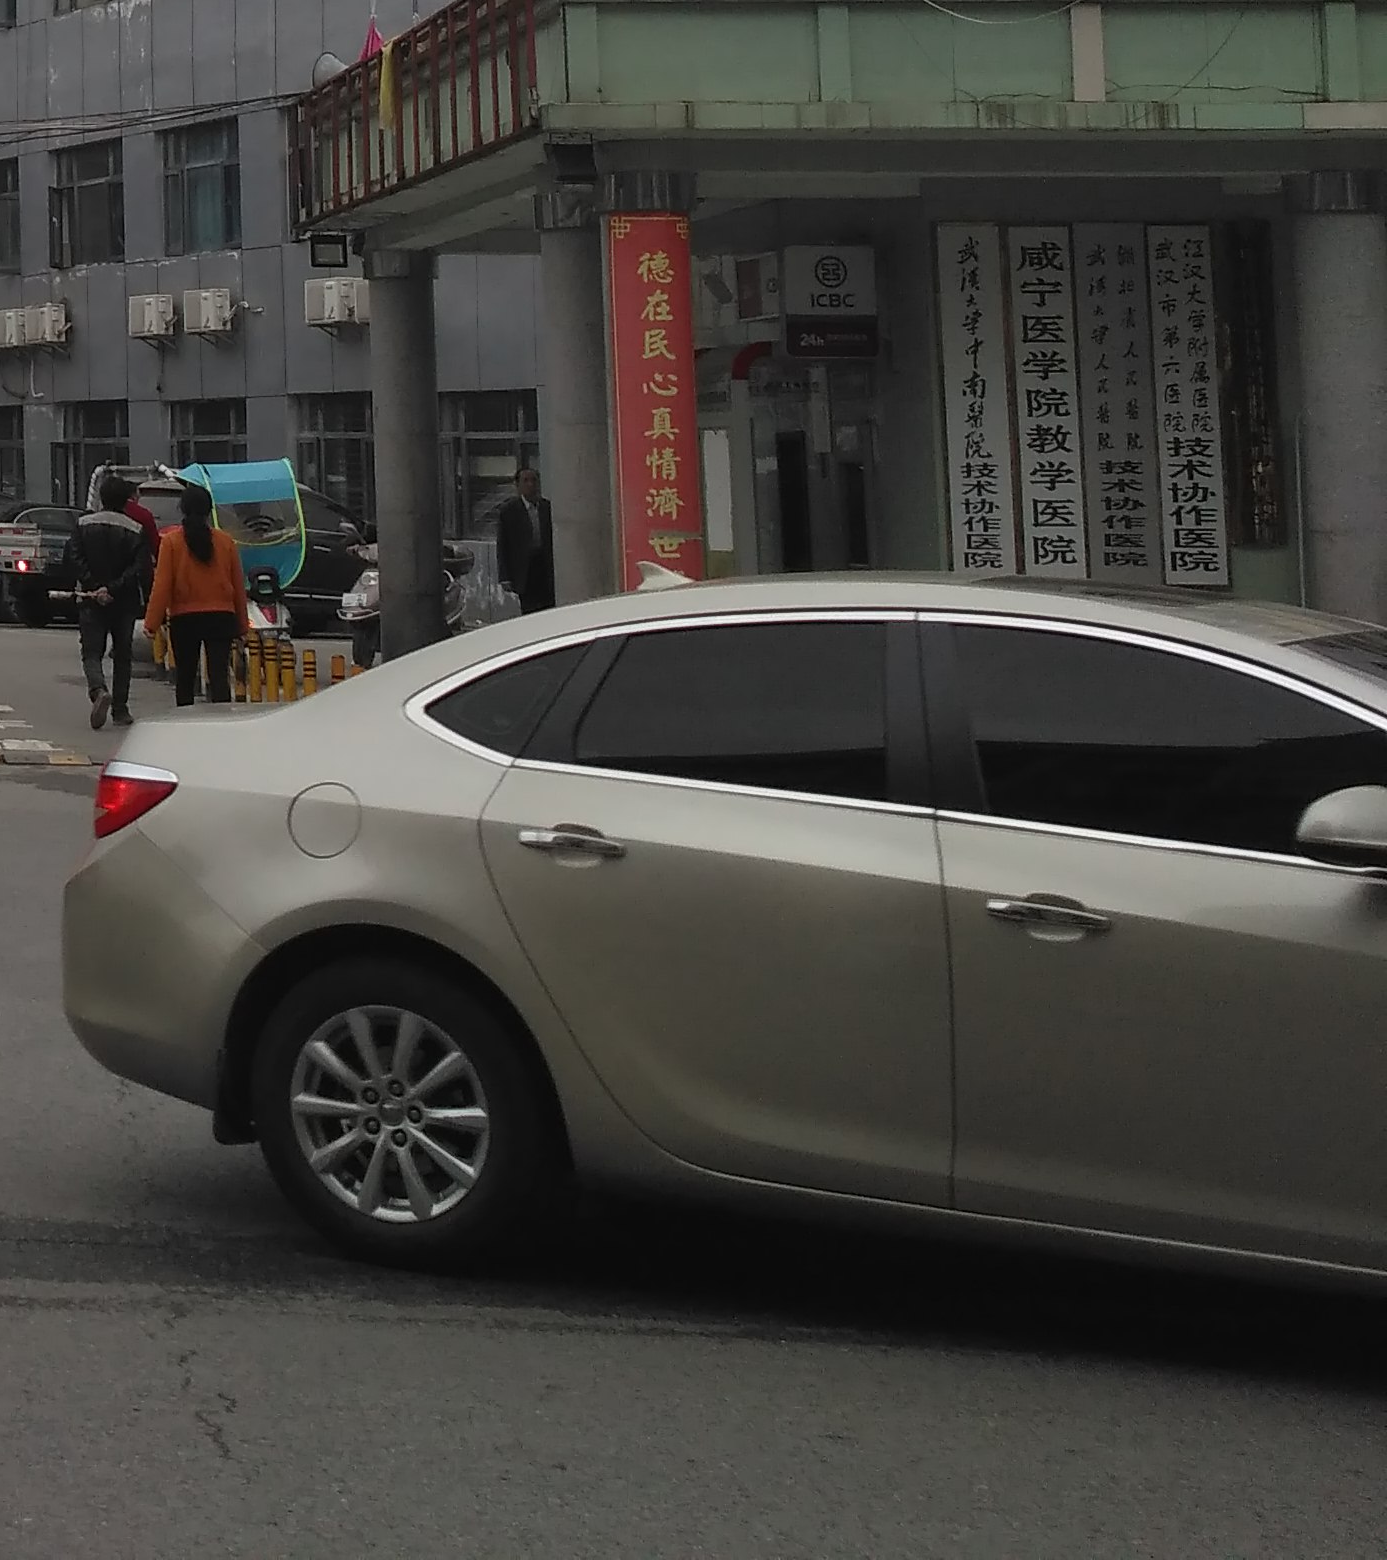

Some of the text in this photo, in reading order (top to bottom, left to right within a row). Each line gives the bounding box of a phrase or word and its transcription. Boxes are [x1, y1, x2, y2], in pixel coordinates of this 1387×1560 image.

[810, 293, 855, 308] ICBC
[1154, 238, 1187, 434] 武汉市第六医院
[1182, 239, 1215, 434] 江汉大学附属医院
[638, 250, 686, 578] 德在民心真情濟世
[1017, 242, 1078, 566] 咸宁医学院教学医院
[1099, 459, 1149, 568] 技术协作医院
[1167, 437, 1220, 572] 技术协作医院
